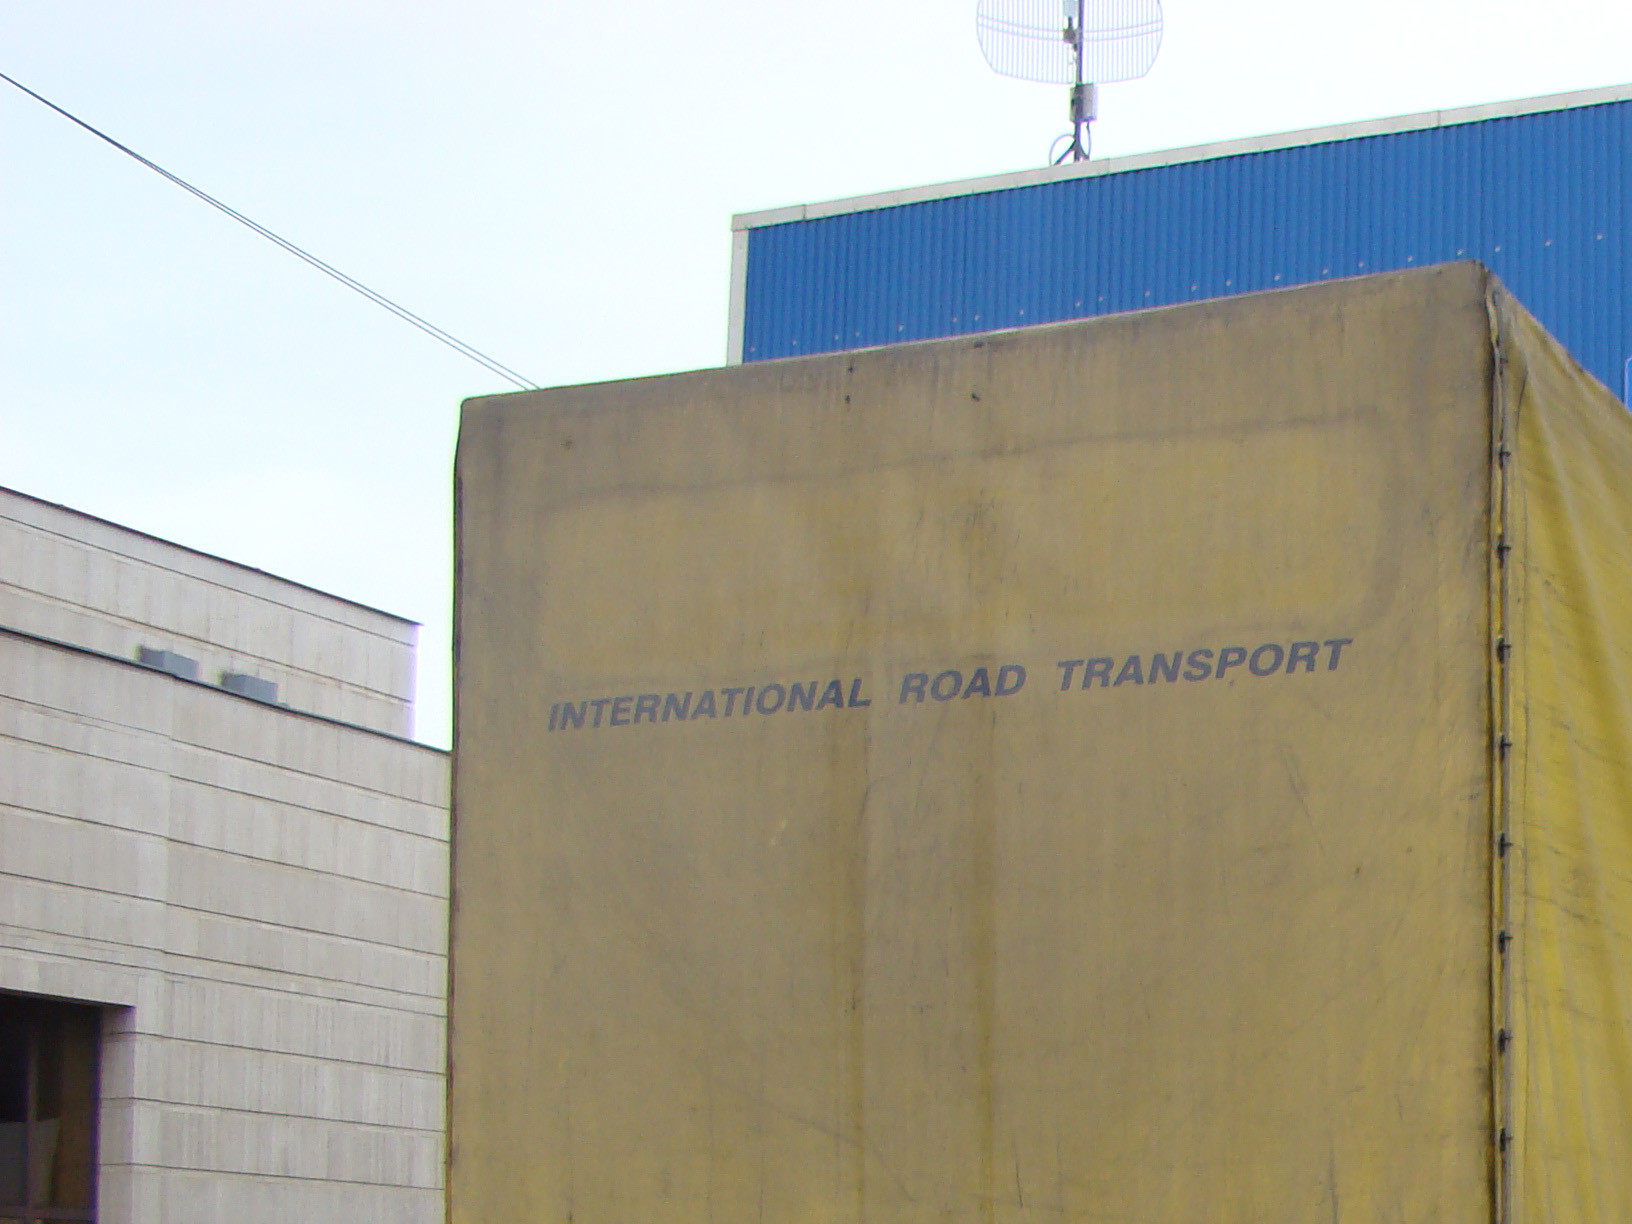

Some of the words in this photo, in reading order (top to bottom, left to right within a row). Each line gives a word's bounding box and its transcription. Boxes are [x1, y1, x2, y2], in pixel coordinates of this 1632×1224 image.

[547, 674, 872, 732] INTERNATIONAL
[898, 663, 1026, 704] ROAD
[1055, 637, 1354, 693] TRANSPORT
